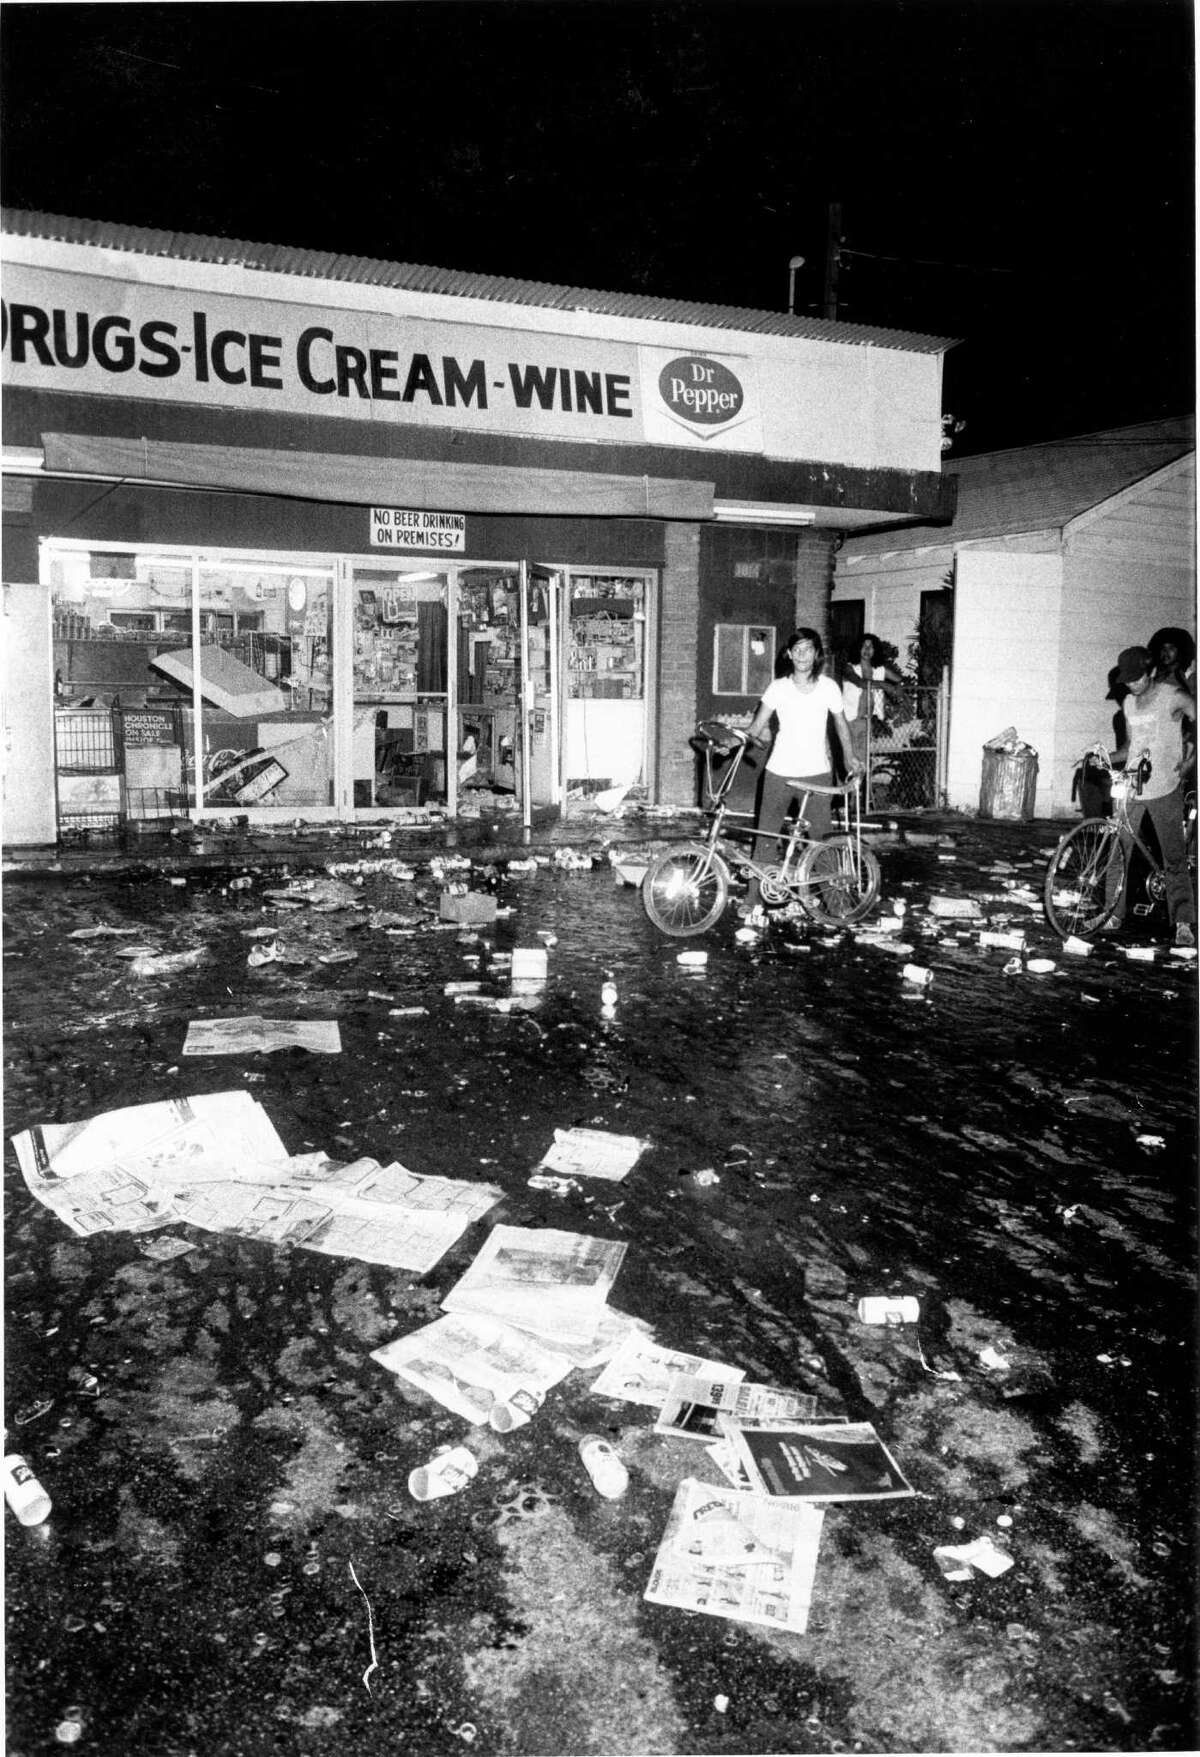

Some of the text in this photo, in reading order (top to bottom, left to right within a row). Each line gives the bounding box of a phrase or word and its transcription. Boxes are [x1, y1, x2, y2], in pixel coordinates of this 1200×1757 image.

[690, 362, 715, 383] Dr
[670, 377, 738, 413] Pepper
[373, 509, 464, 531] NO BEER DRINKING
[377, 528, 460, 548] ON PREMISES!
[124, 714, 166, 722] HOUSTON
[124, 722, 173, 730] CHRONICLE
